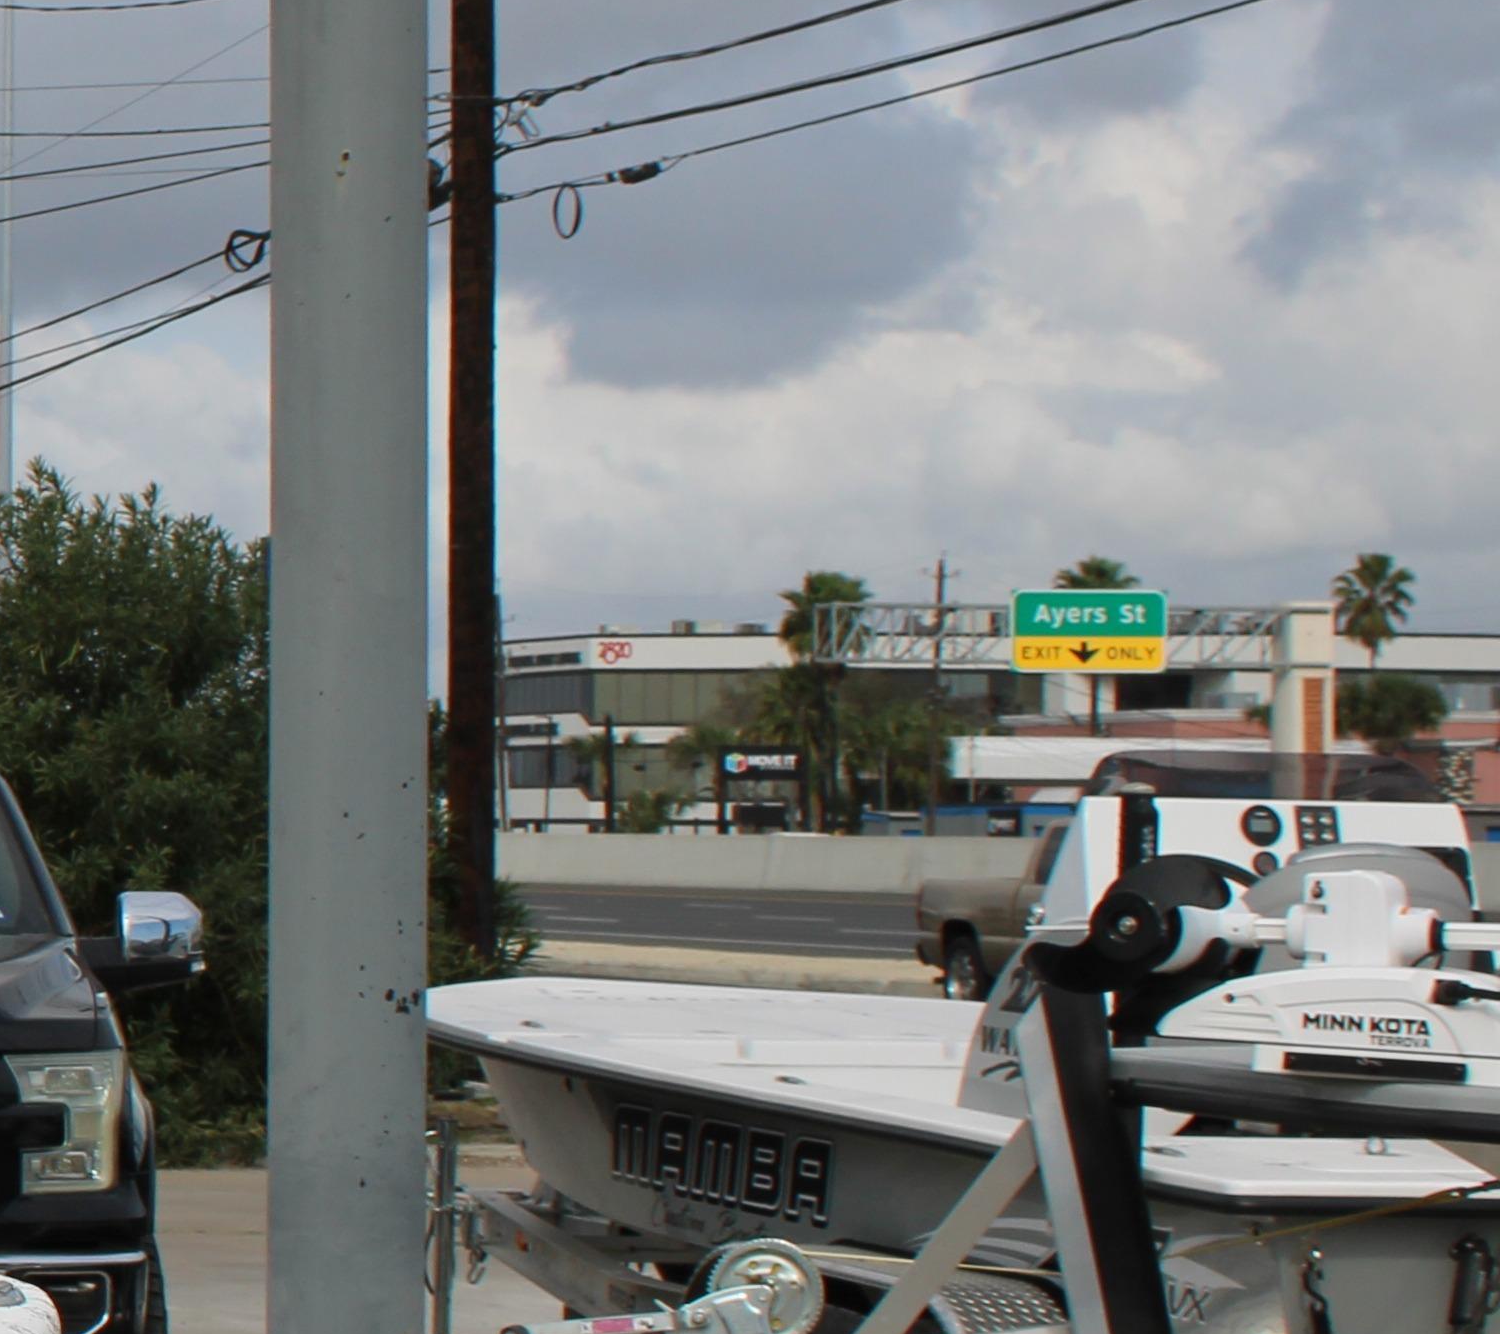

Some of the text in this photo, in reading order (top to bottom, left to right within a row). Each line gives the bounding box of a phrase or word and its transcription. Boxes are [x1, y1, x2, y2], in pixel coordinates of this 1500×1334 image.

[1033, 603, 1146, 629] Ayers St
[1021, 646, 1156, 660] EXIT ONLY
[1302, 1013, 1430, 1035] MINN KOTA
[612, 1103, 833, 1227] MAMBA
